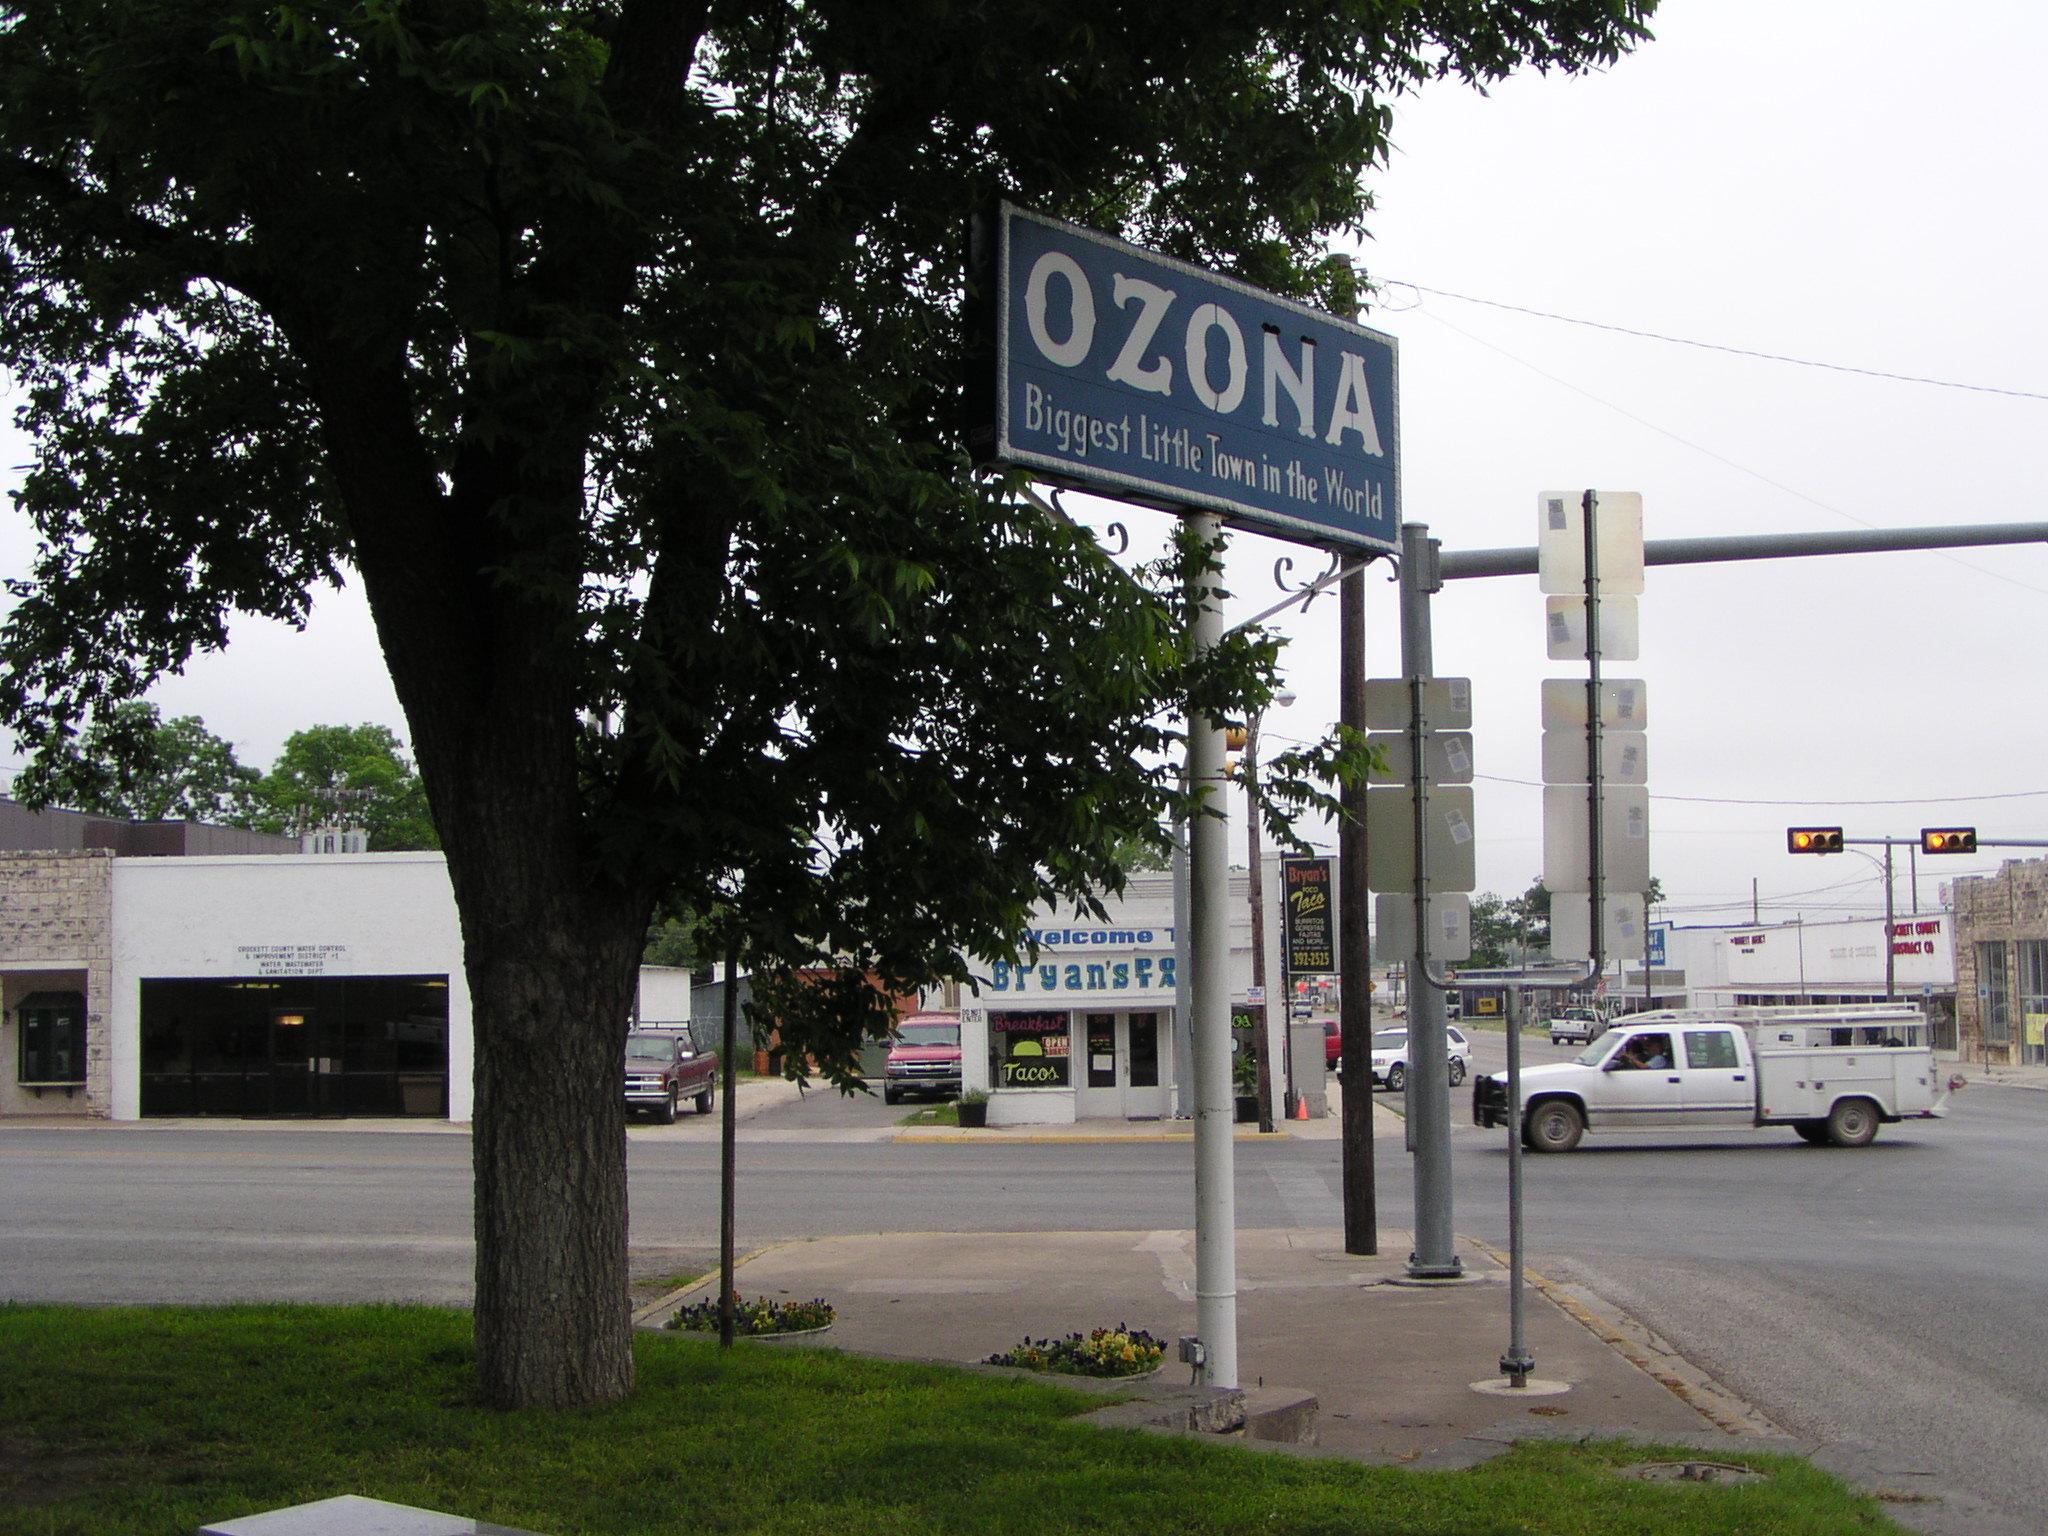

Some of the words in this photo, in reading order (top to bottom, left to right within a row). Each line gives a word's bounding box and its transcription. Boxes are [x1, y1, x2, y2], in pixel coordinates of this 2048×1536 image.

[1025, 251, 1383, 457] OZONA
[1025, 383, 1131, 457] Biggest
[1141, 414, 1202, 472] Little
[1206, 433, 1257, 488] Town
[1262, 454, 1281, 493] in
[1286, 460, 1318, 504] the
[1324, 467, 1383, 521] World
[1289, 866, 1328, 885] Bryan's
[1290, 891, 1326, 913] Taco
[1019, 928, 1154, 945] Welcome
[1135, 957, 1176, 974] PO
[1294, 952, 1330, 966] 392-2525
[992, 959, 1129, 992] Bryan's
[1138, 971, 1176, 988] TA
[991, 1013, 1068, 1033] Breakfast
[1045, 1036, 1069, 1047] OPEN
[1002, 1062, 1059, 1083] Tacos
